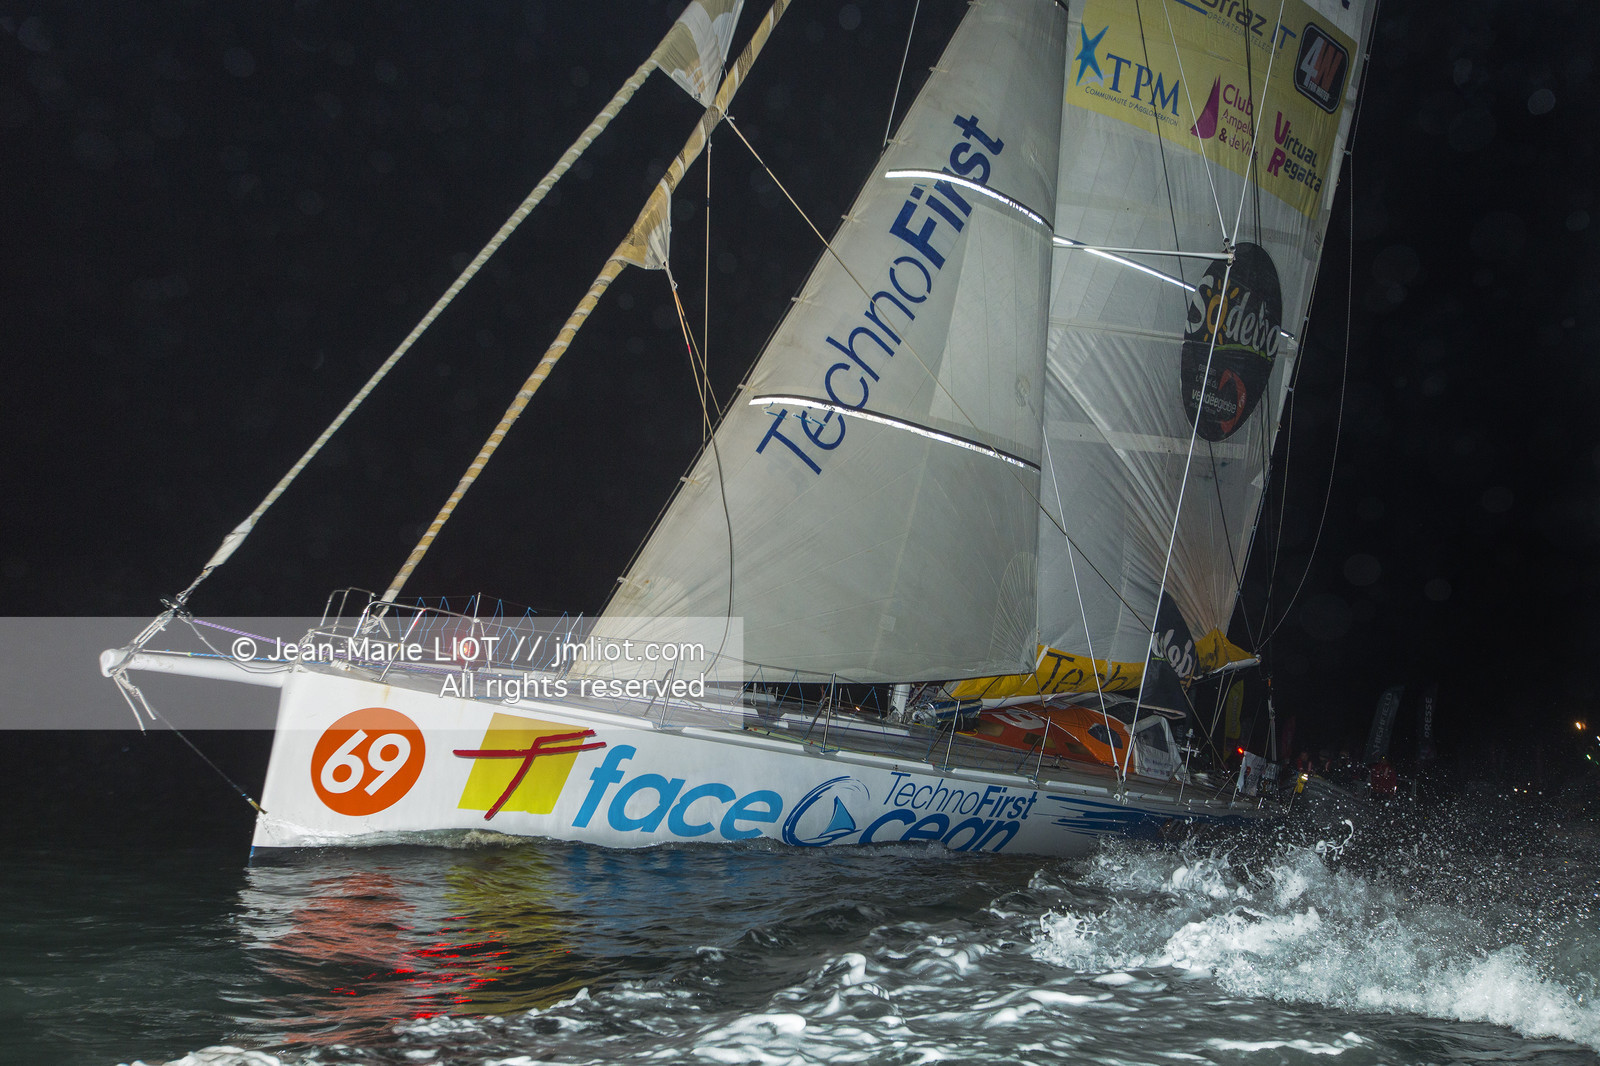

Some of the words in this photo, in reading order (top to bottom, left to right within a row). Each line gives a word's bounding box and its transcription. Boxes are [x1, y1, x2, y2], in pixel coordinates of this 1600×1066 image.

[1207, 12, 1246, 39] OPERATEU
[1106, 53, 1180, 117] TPM
[1223, 84, 1253, 116] Club
[1218, 127, 1228, 143] &
[1274, 111, 1317, 168] Virtual
[1267, 147, 1322, 193] Regatta
[755, 114, 1005, 476] TechnoFirst
[1424, 697, 1433, 738] PRESSE
[320, 729, 412, 797] 69
[571, 744, 784, 841] face
[883, 771, 1038, 820] TechnoFirst
